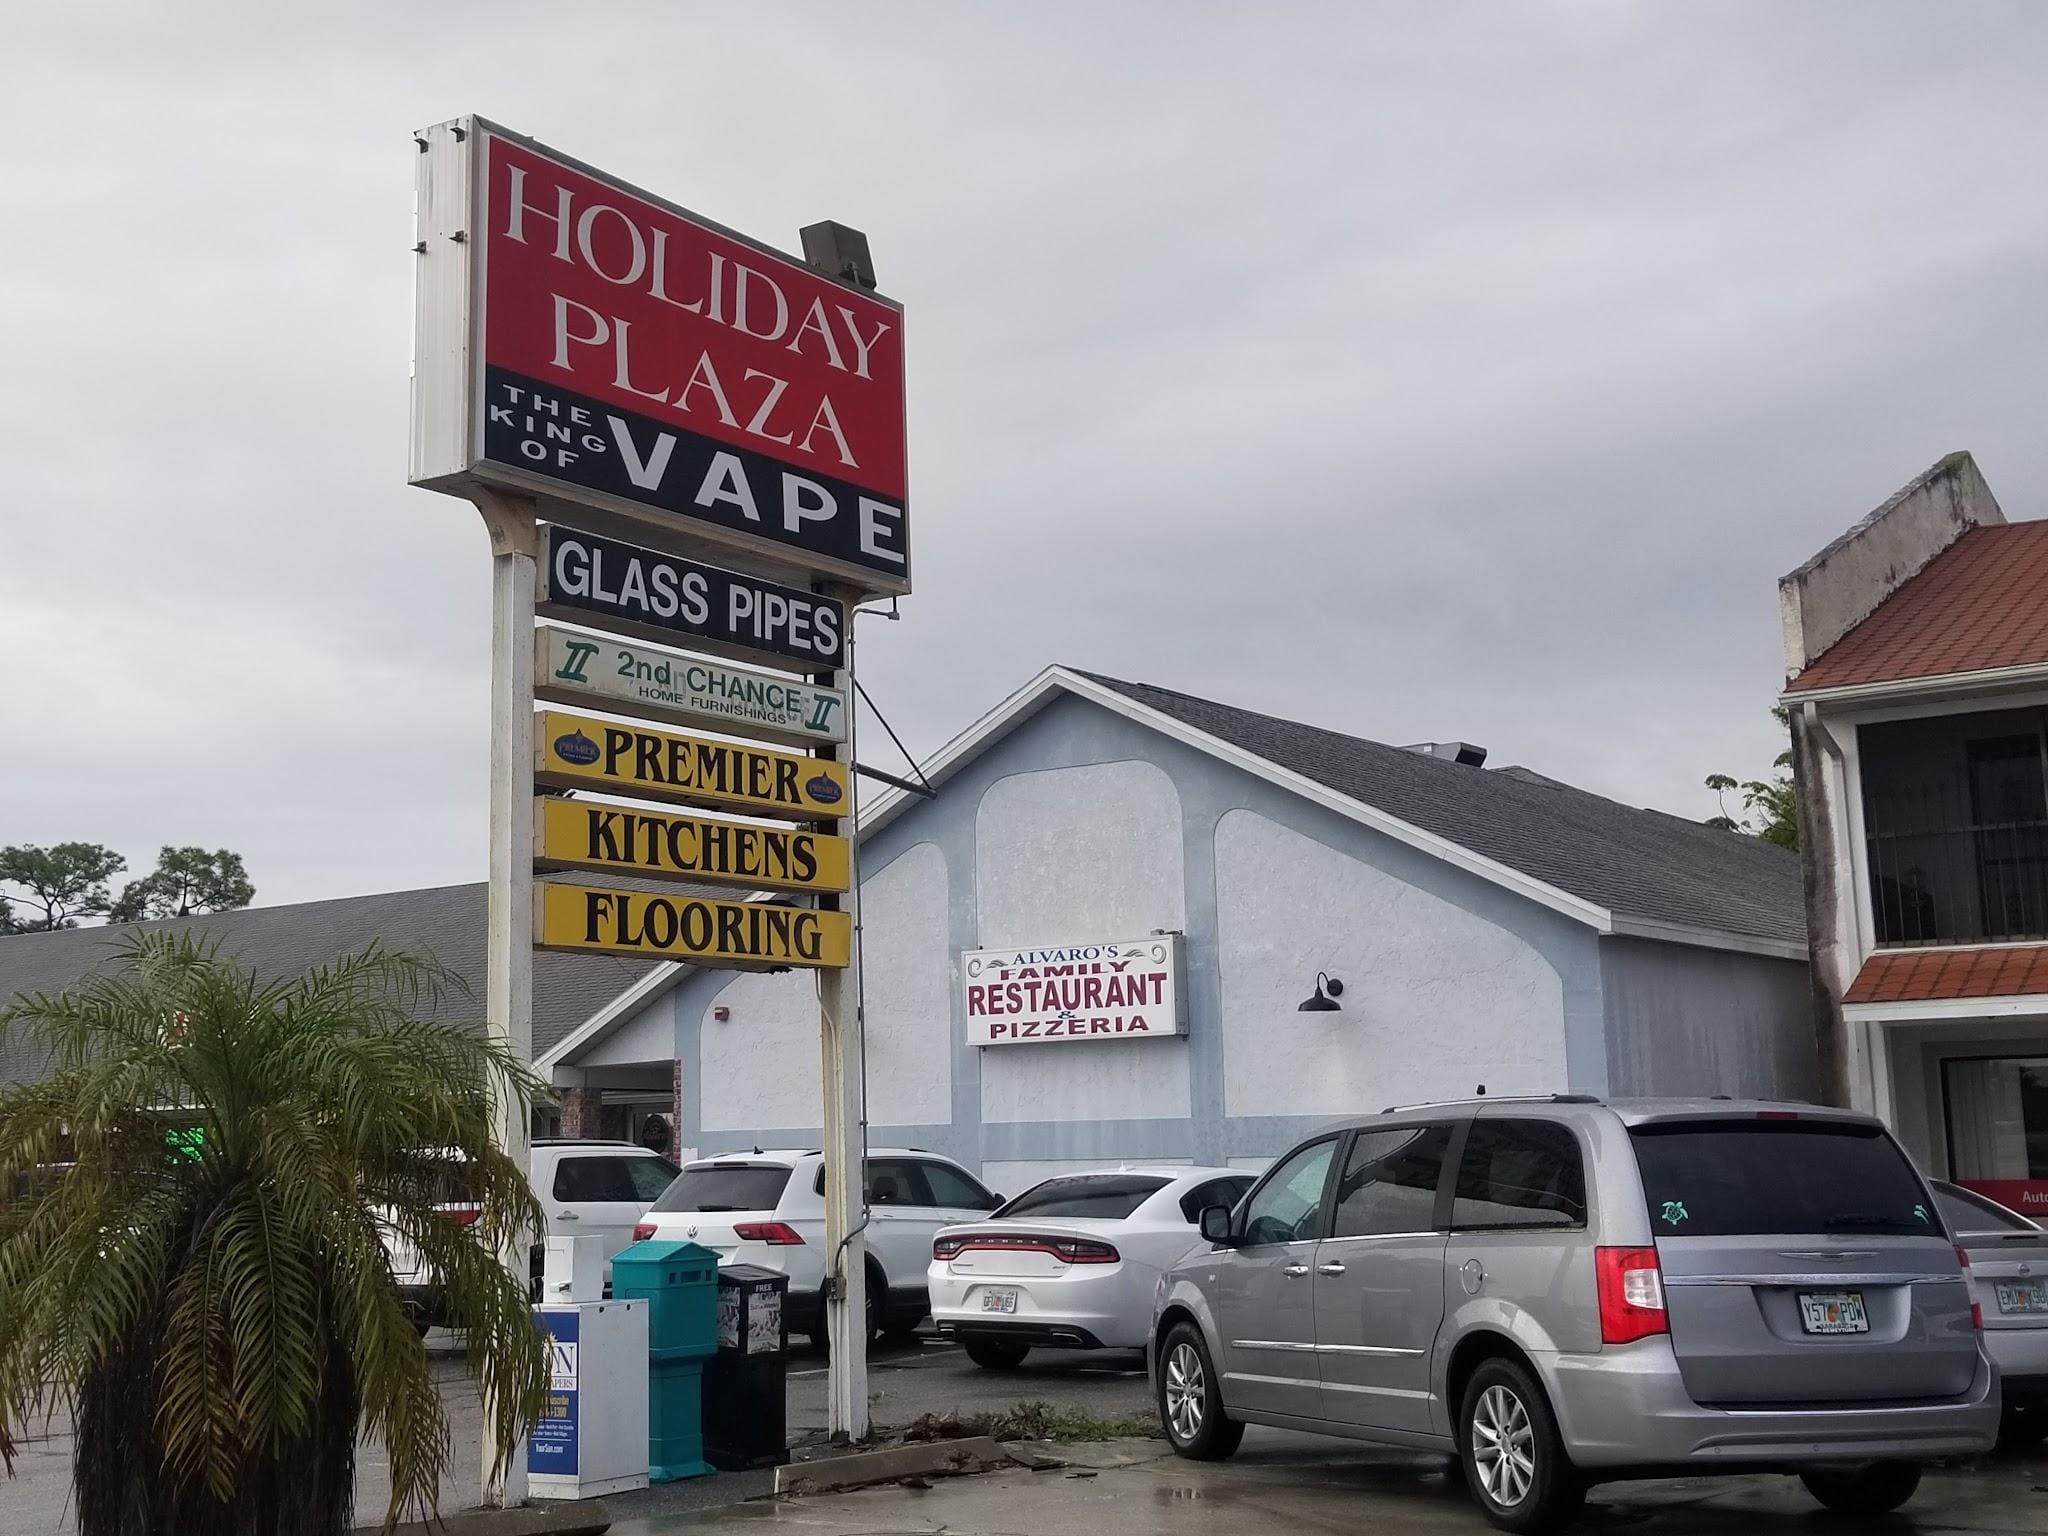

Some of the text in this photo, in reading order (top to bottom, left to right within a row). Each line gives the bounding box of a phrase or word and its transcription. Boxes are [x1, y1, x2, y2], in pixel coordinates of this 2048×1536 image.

[502, 163, 892, 381] HOLIDAY
[549, 293, 860, 469] PLAZA
[502, 384, 592, 427] THE
[490, 405, 607, 454] KING
[521, 440, 580, 469] OF
[606, 414, 905, 564] VAPE
[555, 540, 839, 656] GLASS PIPES
[617, 651, 671, 686] 2nd
[686, 666, 801, 713] CHANCE
[638, 686, 787, 725] HOME FURNISHINGS
[604, 727, 803, 804] PREMIER
[587, 809, 818, 882] KITCHENS
[585, 891, 823, 960] FLOORING
[1000, 960, 1133, 981] FAMILY
[1013, 945, 1119, 965] ALVARO'S
[968, 972, 1168, 1017] RESTAURANT
[1057, 1010, 1076, 1020] &
[989, 1015, 1150, 1040] PIZZERIA
[755, 1283, 773, 1292] FREE
